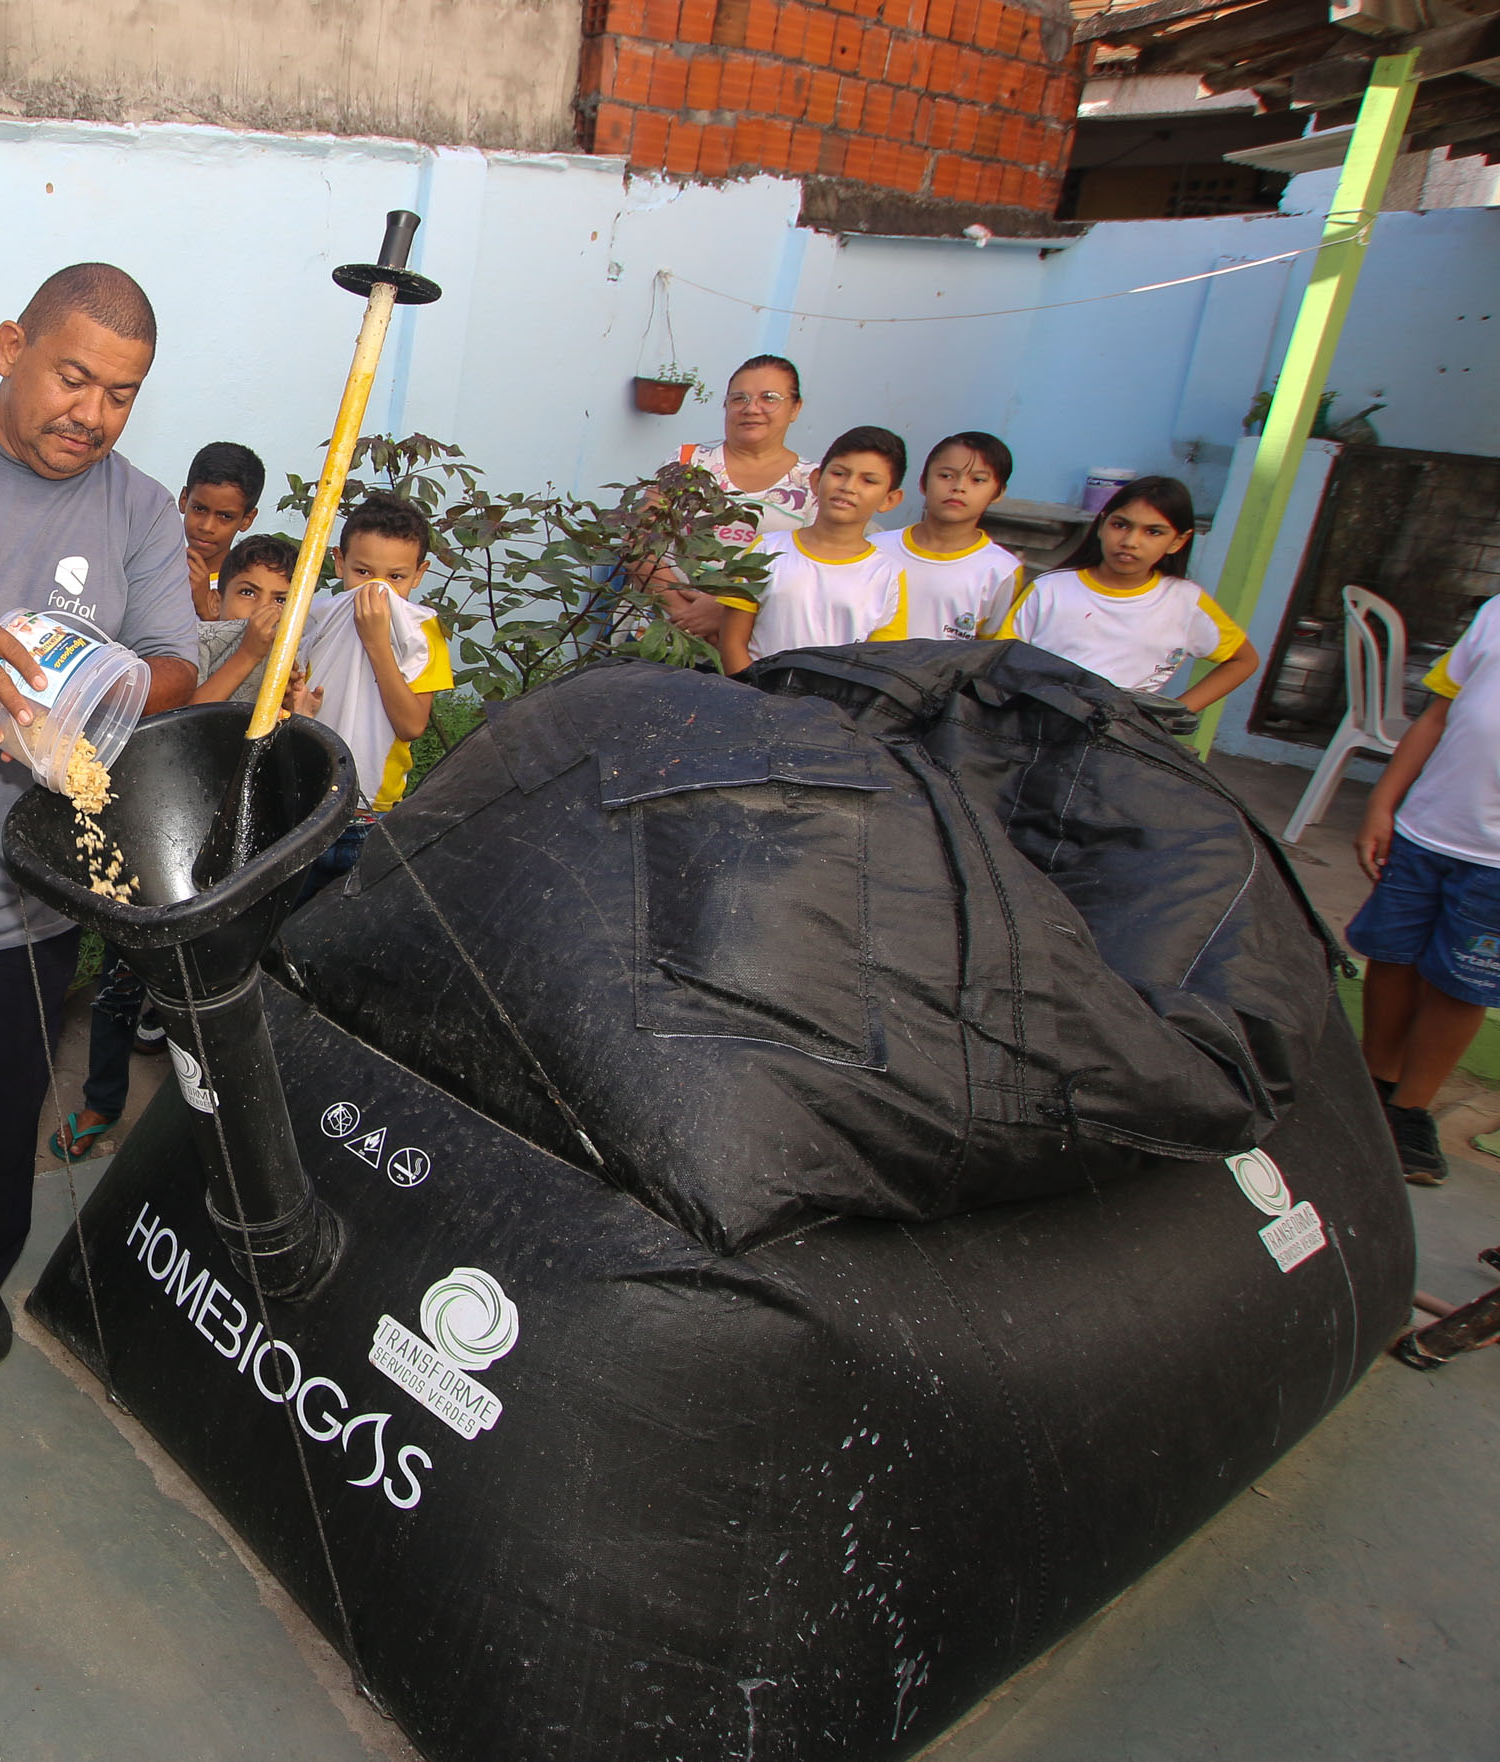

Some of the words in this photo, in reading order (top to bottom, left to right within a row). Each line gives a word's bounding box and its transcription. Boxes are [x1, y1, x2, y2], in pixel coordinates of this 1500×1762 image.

[47, 590, 97, 621] fortal
[373, 1347, 427, 1395] SERVIÇOS
[427, 1387, 477, 1433] VERDES
[377, 1320, 498, 1424] TRANSFORME
